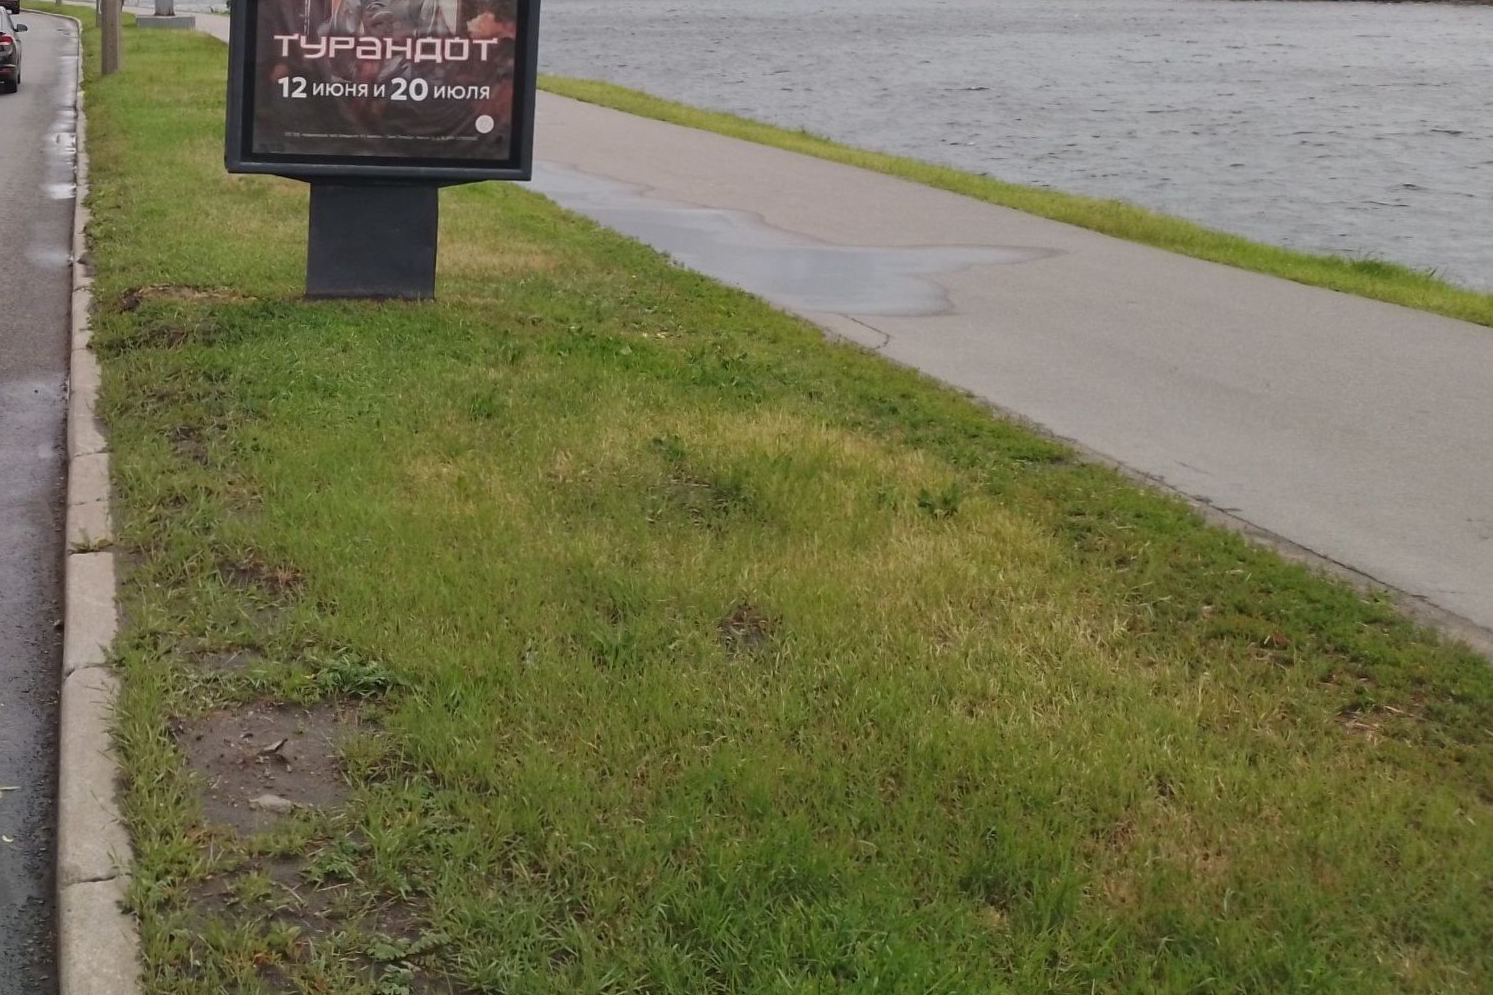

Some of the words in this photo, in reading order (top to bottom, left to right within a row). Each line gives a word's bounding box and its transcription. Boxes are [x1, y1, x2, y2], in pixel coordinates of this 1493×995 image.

[277, 76, 307, 98] 12
[312, 82, 368, 97] июня
[374, 83, 385, 97] и
[390, 77, 428, 101] 20
[433, 85, 491, 100] июля
